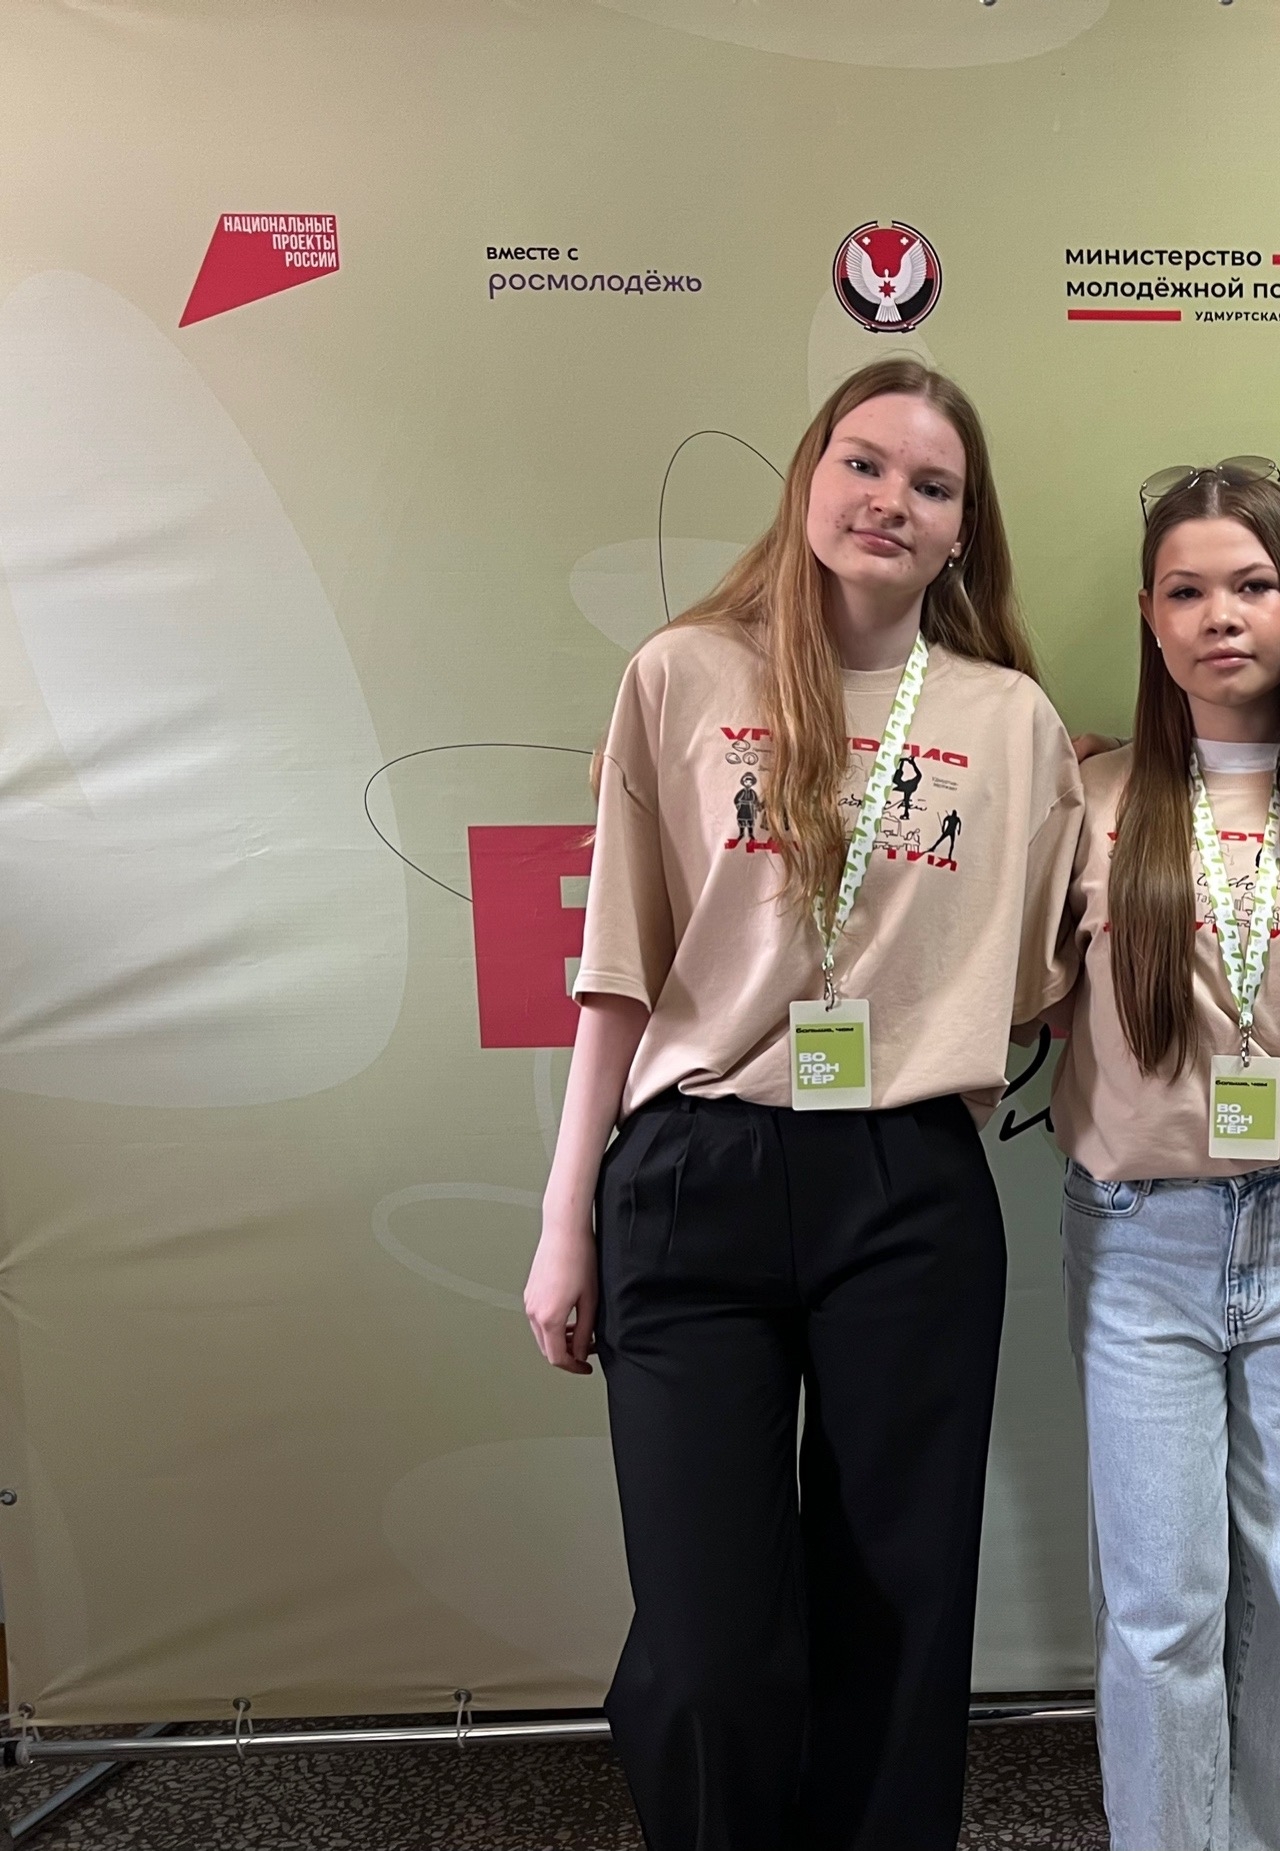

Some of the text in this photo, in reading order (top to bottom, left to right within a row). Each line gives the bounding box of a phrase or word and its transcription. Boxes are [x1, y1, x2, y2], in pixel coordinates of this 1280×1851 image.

[223, 216, 335, 234] НАЦИОНАЛЬНЫЕ
[272, 233, 336, 251] ПРОЕКТЫ
[285, 251, 338, 268] РОССИИ
[487, 246, 580, 262] вместе с
[1065, 246, 1263, 272] министерство
[488, 269, 703, 300] росмолодёжь
[1065, 277, 1245, 303] молодёжной
[799, 1052, 826, 1062] ВО
[799, 1063, 839, 1074] ЛОН
[799, 1072, 835, 1085] ТЁР
[1216, 1103, 1241, 1113] ВО
[1216, 1114, 1253, 1124] ЛОН
[1216, 1122, 1248, 1134] ТЁР
